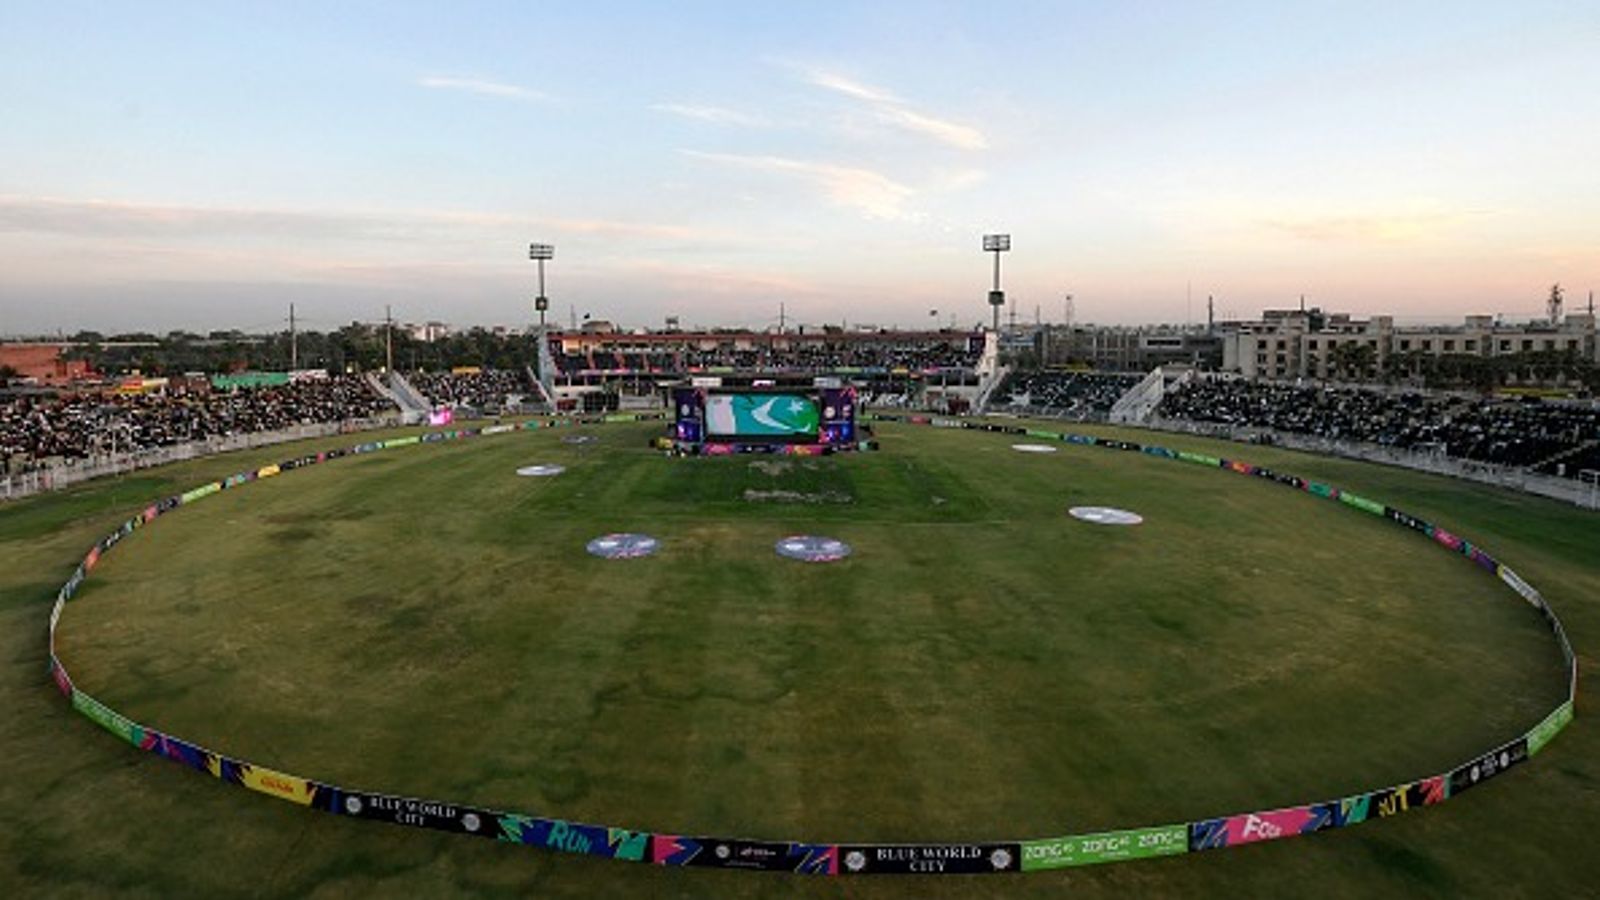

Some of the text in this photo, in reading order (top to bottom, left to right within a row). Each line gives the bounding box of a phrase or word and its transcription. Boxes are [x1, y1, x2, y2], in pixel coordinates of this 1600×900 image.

[405, 800, 456, 818] WORLD
[877, 846, 982, 861] BLUE WORLD
[909, 860, 946, 872] CITY
